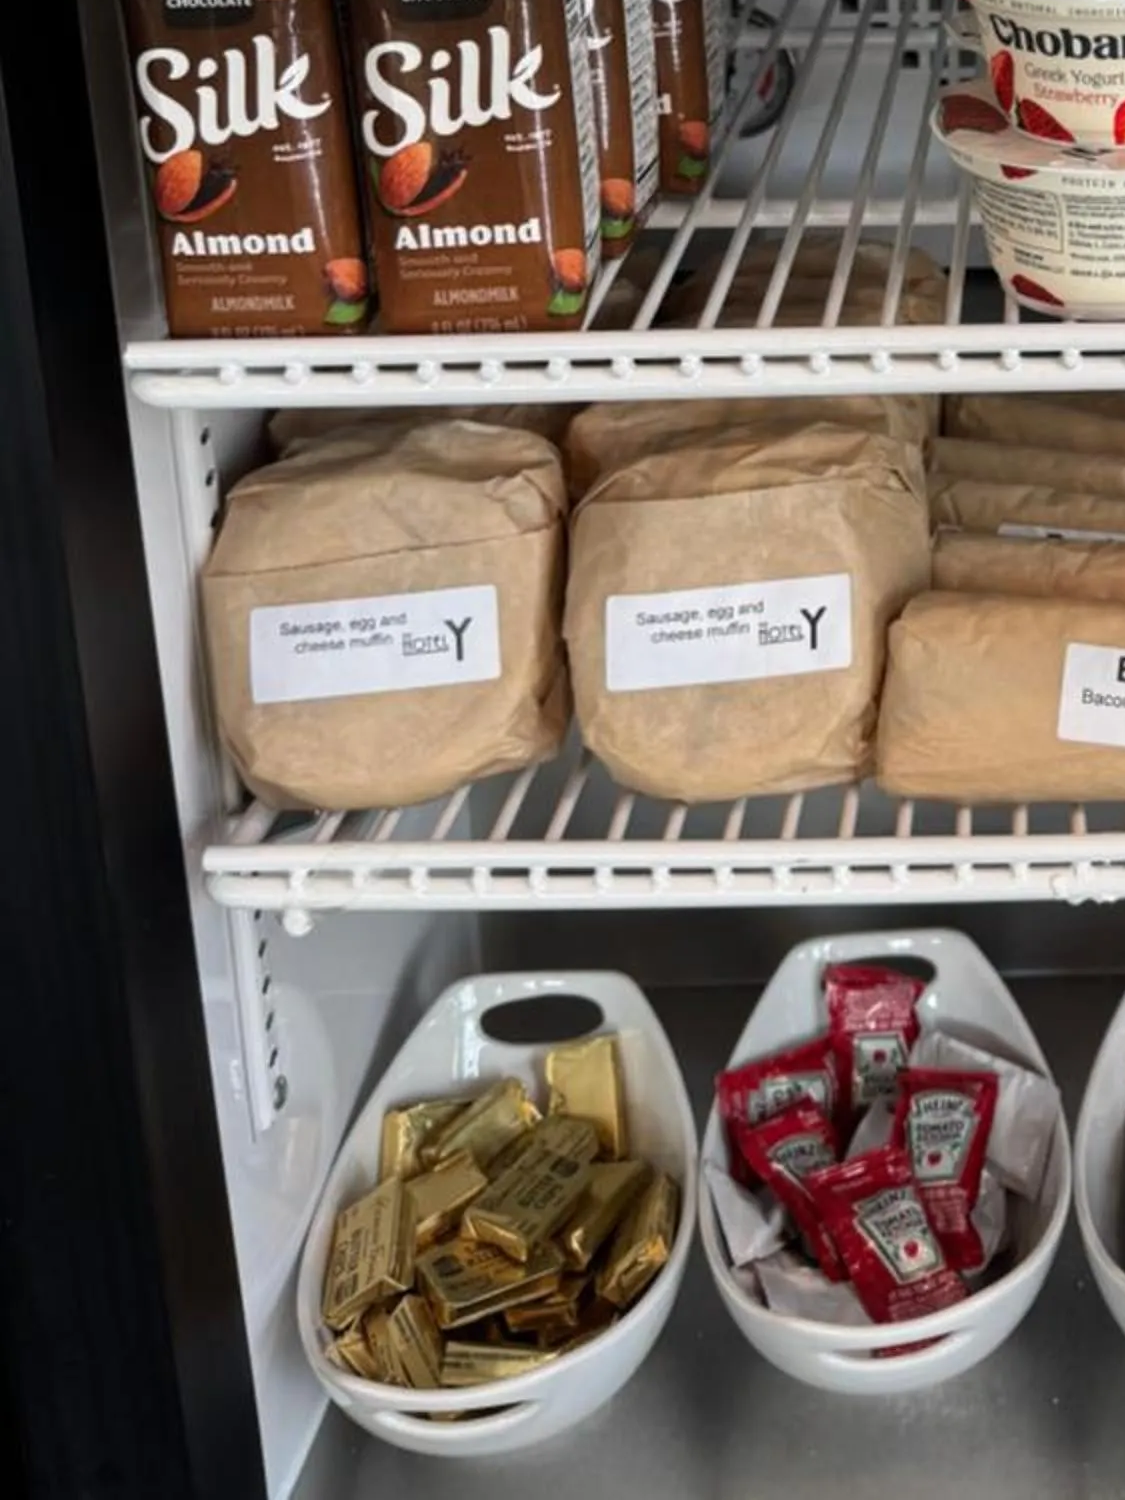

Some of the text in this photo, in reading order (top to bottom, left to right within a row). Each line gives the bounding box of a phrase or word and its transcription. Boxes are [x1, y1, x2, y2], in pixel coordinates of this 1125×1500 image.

[1024, 62, 1125, 89] Greek Yogurt
[136, 34, 332, 164] Silk
[362, 24, 562, 157] Silk
[1033, 82, 1121, 108] Strawberry
[171, 226, 316, 257] Almond
[394, 216, 542, 251] Almond
[210, 293, 296, 312] ALMONDMILK
[431, 286, 520, 307] ALMONDMILK
[349, 616, 377, 632] egg
[380, 613, 408, 628] and
[635, 601, 765, 627] Sausage, egg and
[650, 627, 704, 645] cheese
[706, 621, 751, 639] muffin
[799, 604, 827, 651] Y
[294, 638, 346, 654] cheese
[349, 634, 394, 650] muffin
[443, 616, 473, 662] Y
